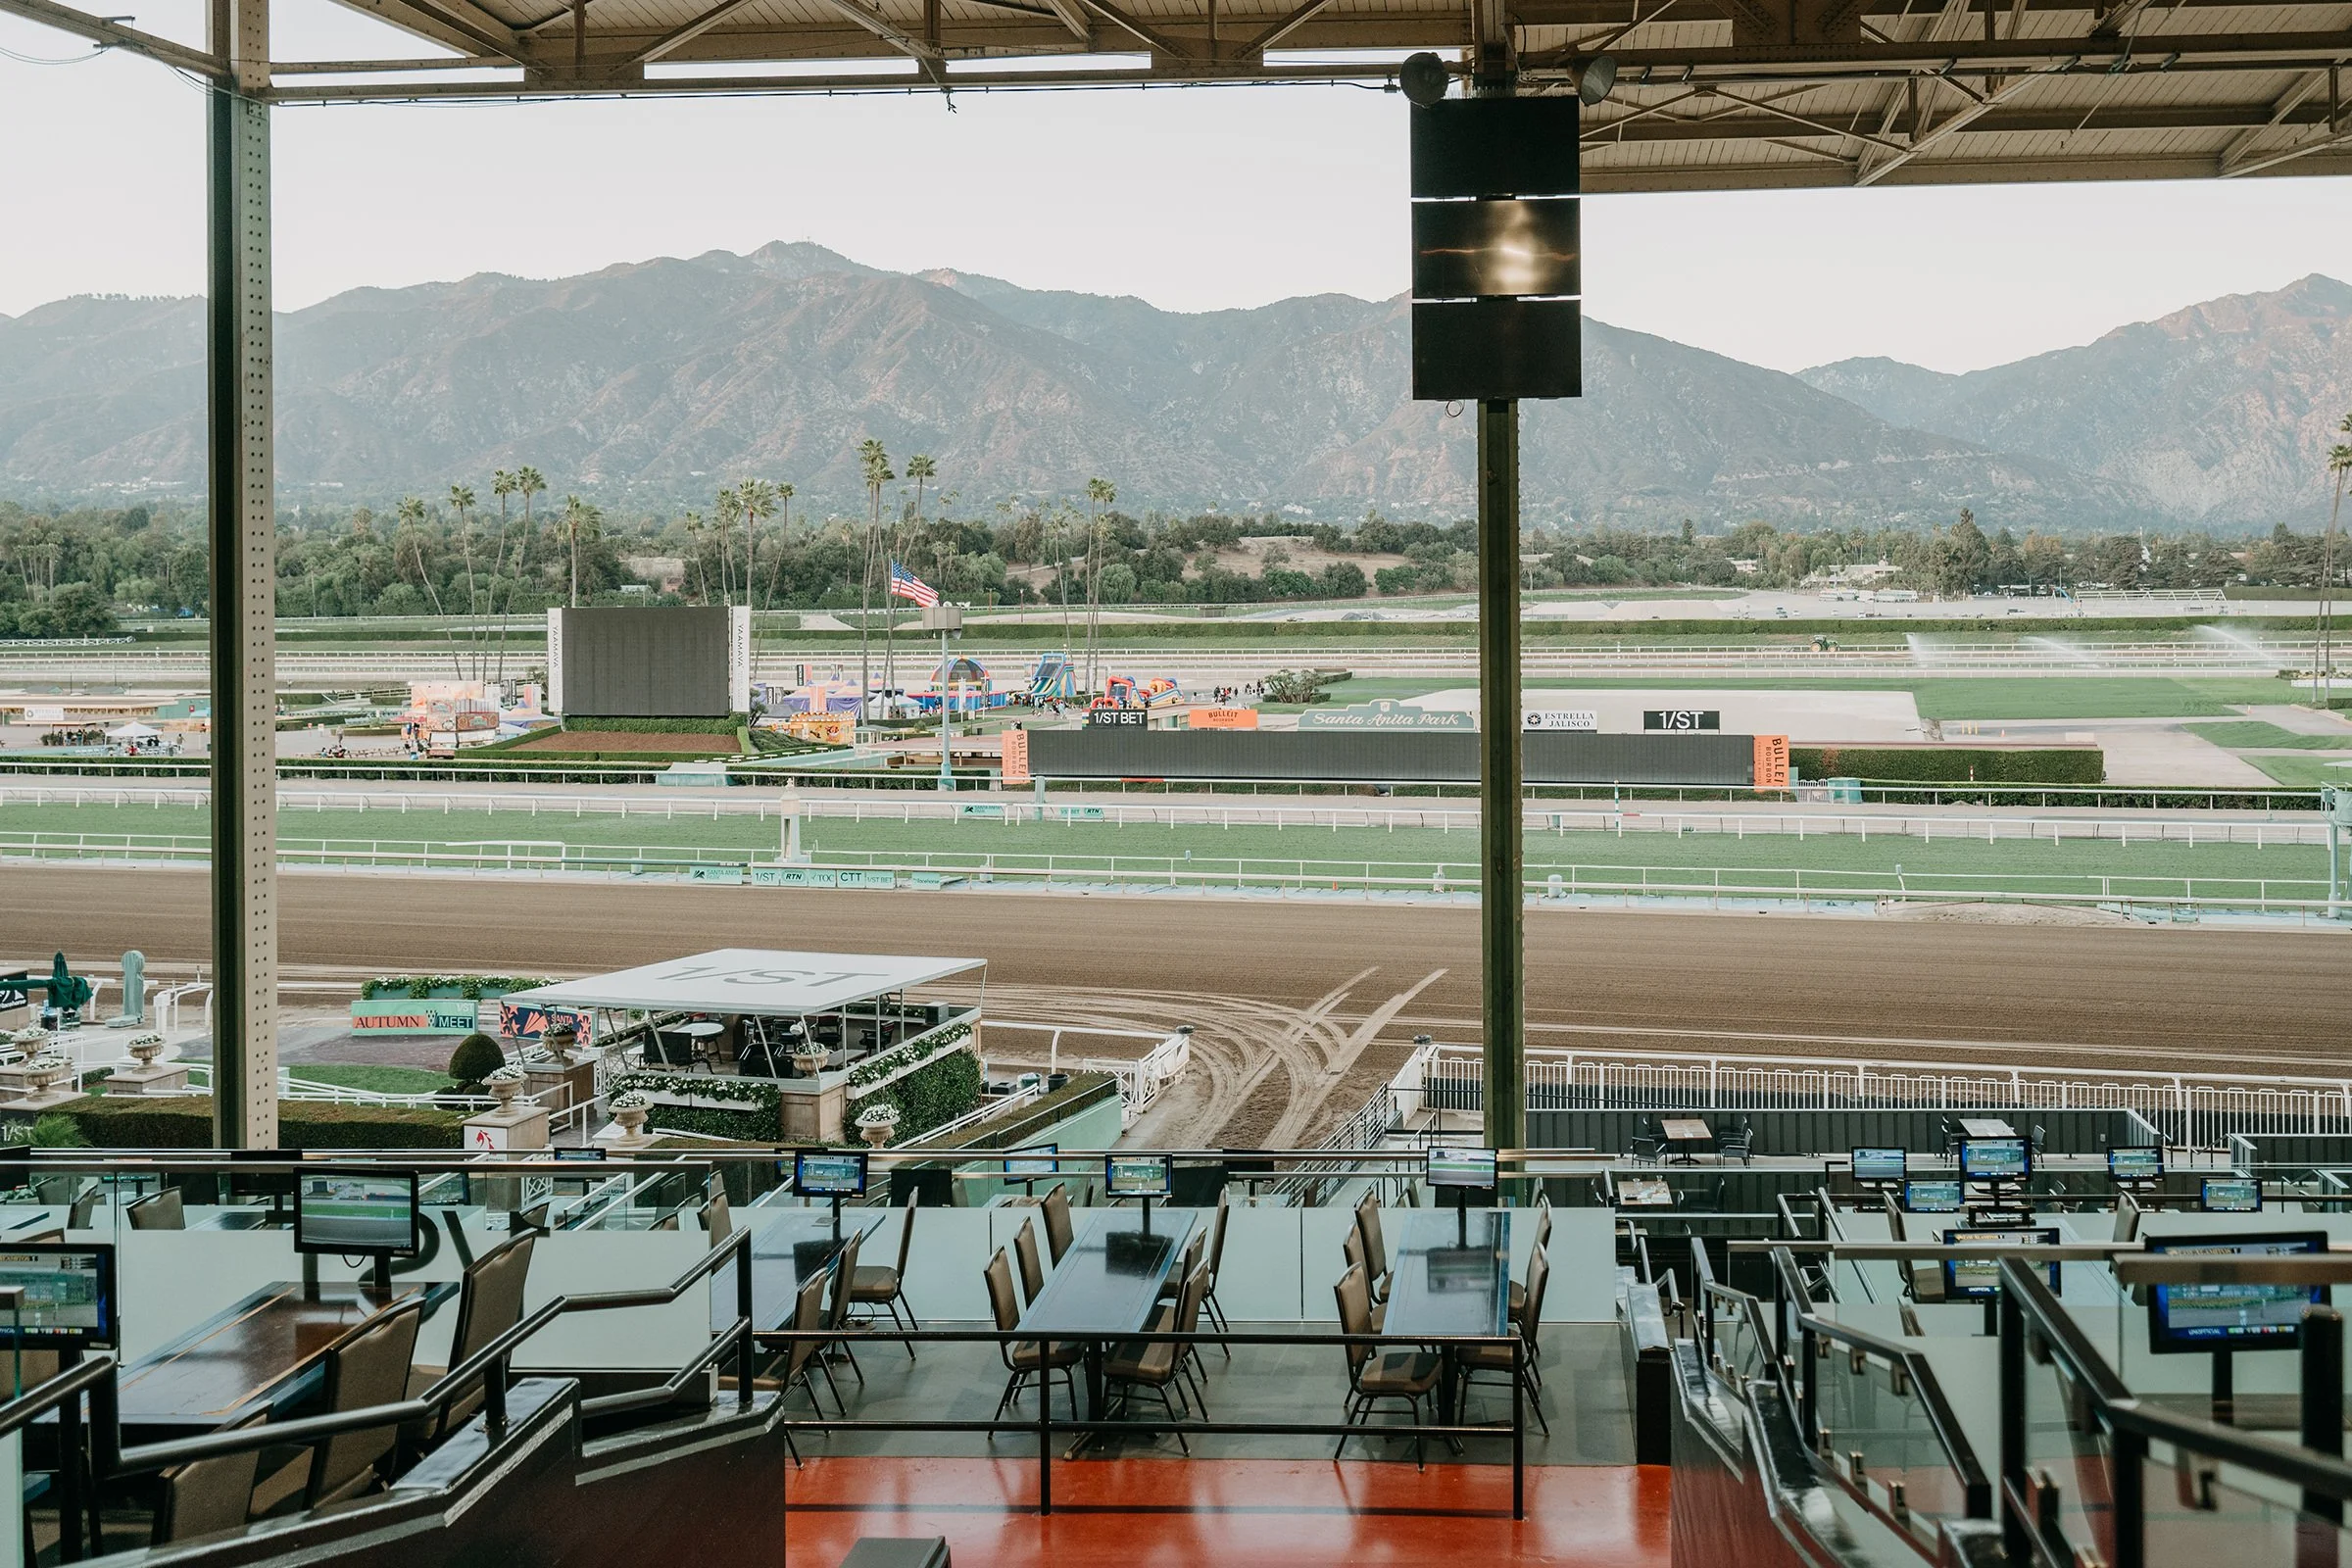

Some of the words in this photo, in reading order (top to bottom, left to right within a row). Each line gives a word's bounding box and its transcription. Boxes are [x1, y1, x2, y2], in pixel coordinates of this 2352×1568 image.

[1094, 711, 1119, 724] 1/ST
[1121, 711, 1145, 724] BET
[1312, 713, 1364, 725] Santa
[1367, 713, 1414, 726] Anita
[1417, 713, 1459, 725] Park
[1658, 711, 1704, 729] 1/ST
[1772, 738, 1785, 787] BULLEI
[756, 872, 775, 882] 1/ST
[840, 872, 861, 882] CTT
[655, 966, 890, 987] 1/ST
[355, 1015, 420, 1028] AUTUMN
[438, 1016, 472, 1028] MEET
[551, 1014, 574, 1025] SANTA
